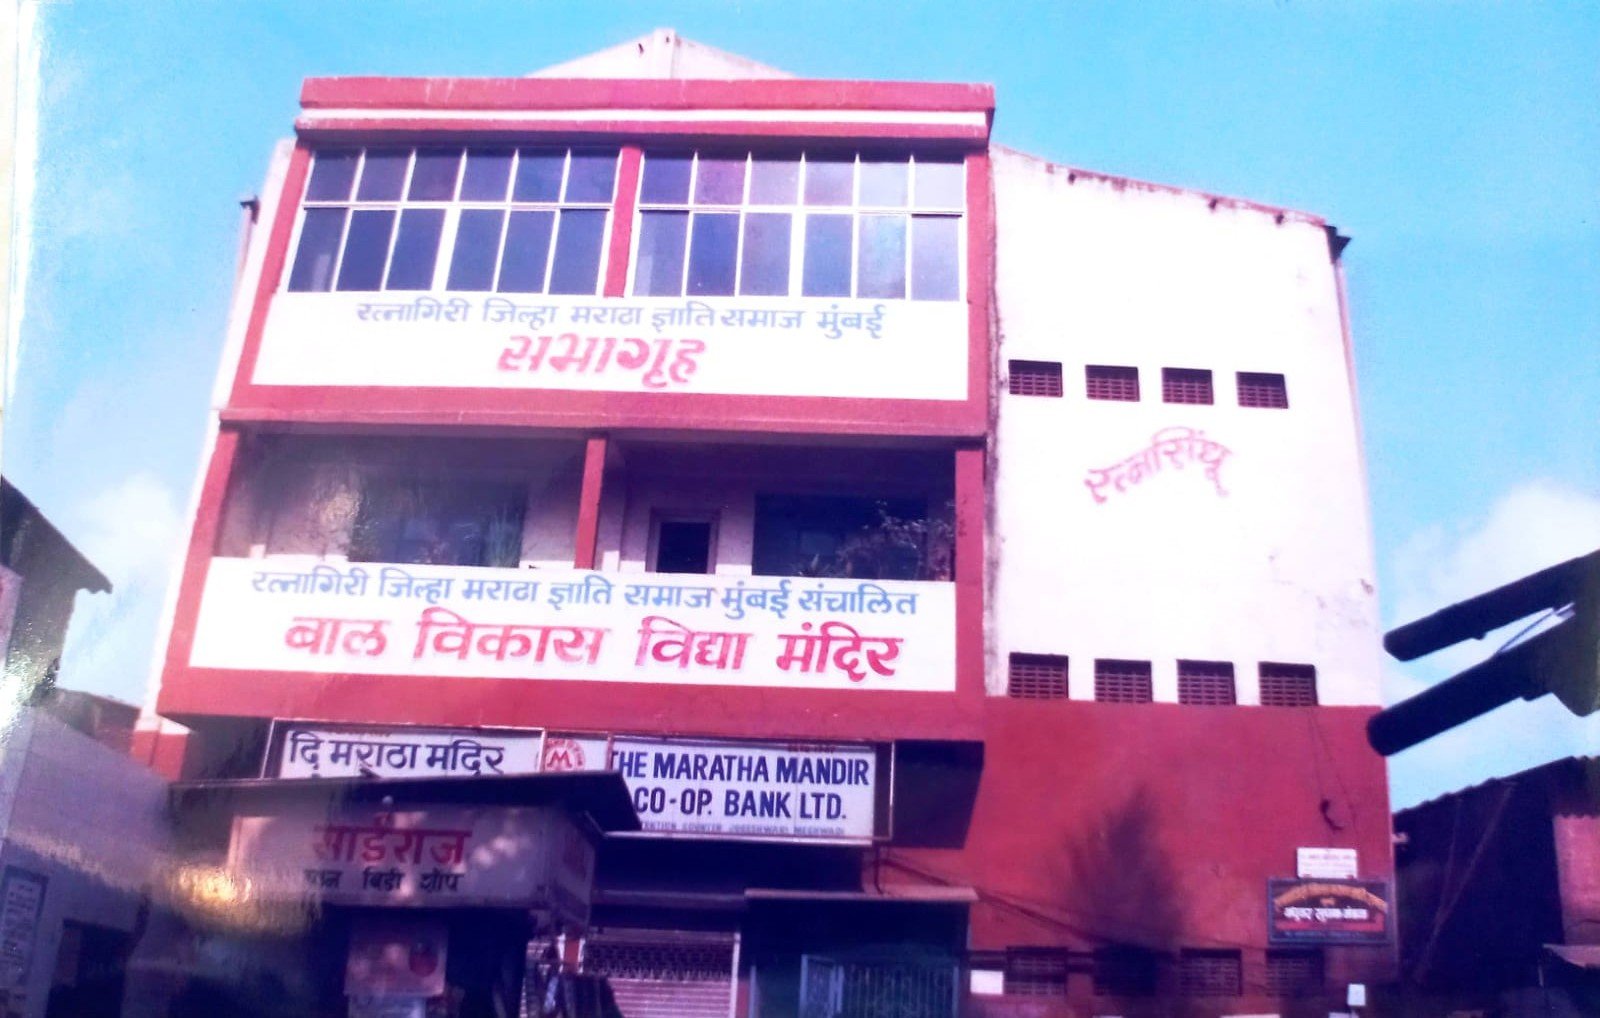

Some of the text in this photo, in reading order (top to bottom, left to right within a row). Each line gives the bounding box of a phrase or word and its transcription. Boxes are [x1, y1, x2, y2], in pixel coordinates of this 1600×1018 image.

[357, 296, 886, 339] रत्नागिरी जिल्हा मराठा ज्ञाति समाज मुंबई
[498, 333, 707, 388] सभागृह
[251, 565, 919, 620] रत्नागिरी जिल्हा मराठा ज्ञाति समाज मुंबई संचालित
[284, 606, 904, 682] बाल विकास विद्या मंदिर
[289, 731, 324, 770] दि
[328, 739, 421, 770] मराठा
[652, 752, 769, 782] MARATHA
[775, 756, 869, 785] MANDIR
[633, 787, 847, 820] CO-OP. BANK LTD.
[313, 812, 473, 865] साईराज
